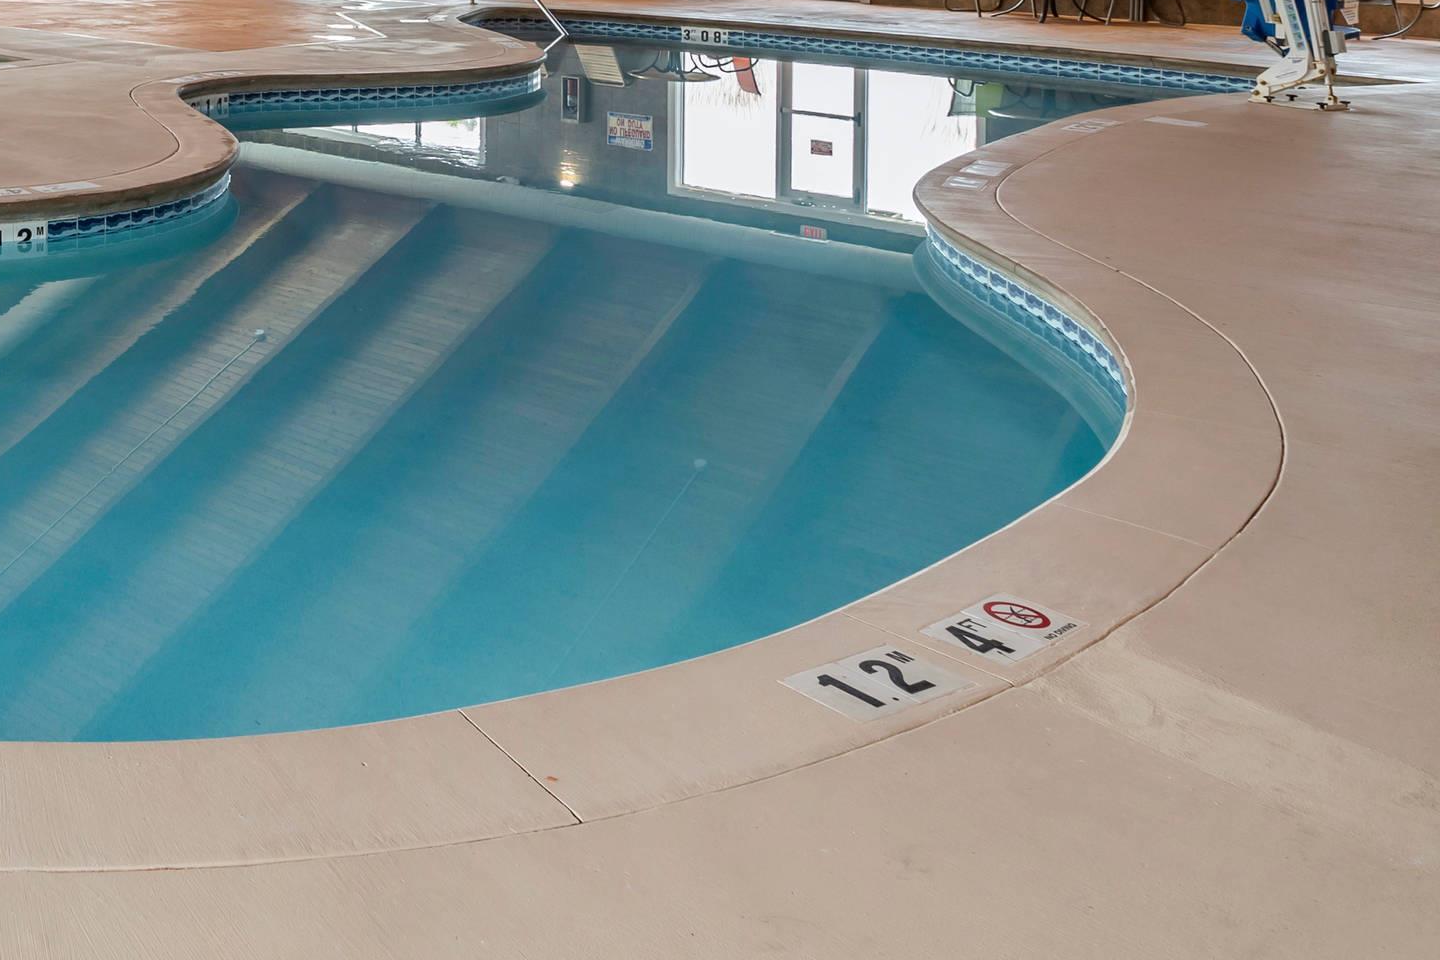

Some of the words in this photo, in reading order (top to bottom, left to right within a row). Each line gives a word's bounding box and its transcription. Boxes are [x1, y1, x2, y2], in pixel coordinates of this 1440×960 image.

[957, 618, 988, 633] FT
[945, 625, 1017, 654] 4
[1043, 632, 1058, 640] NO
